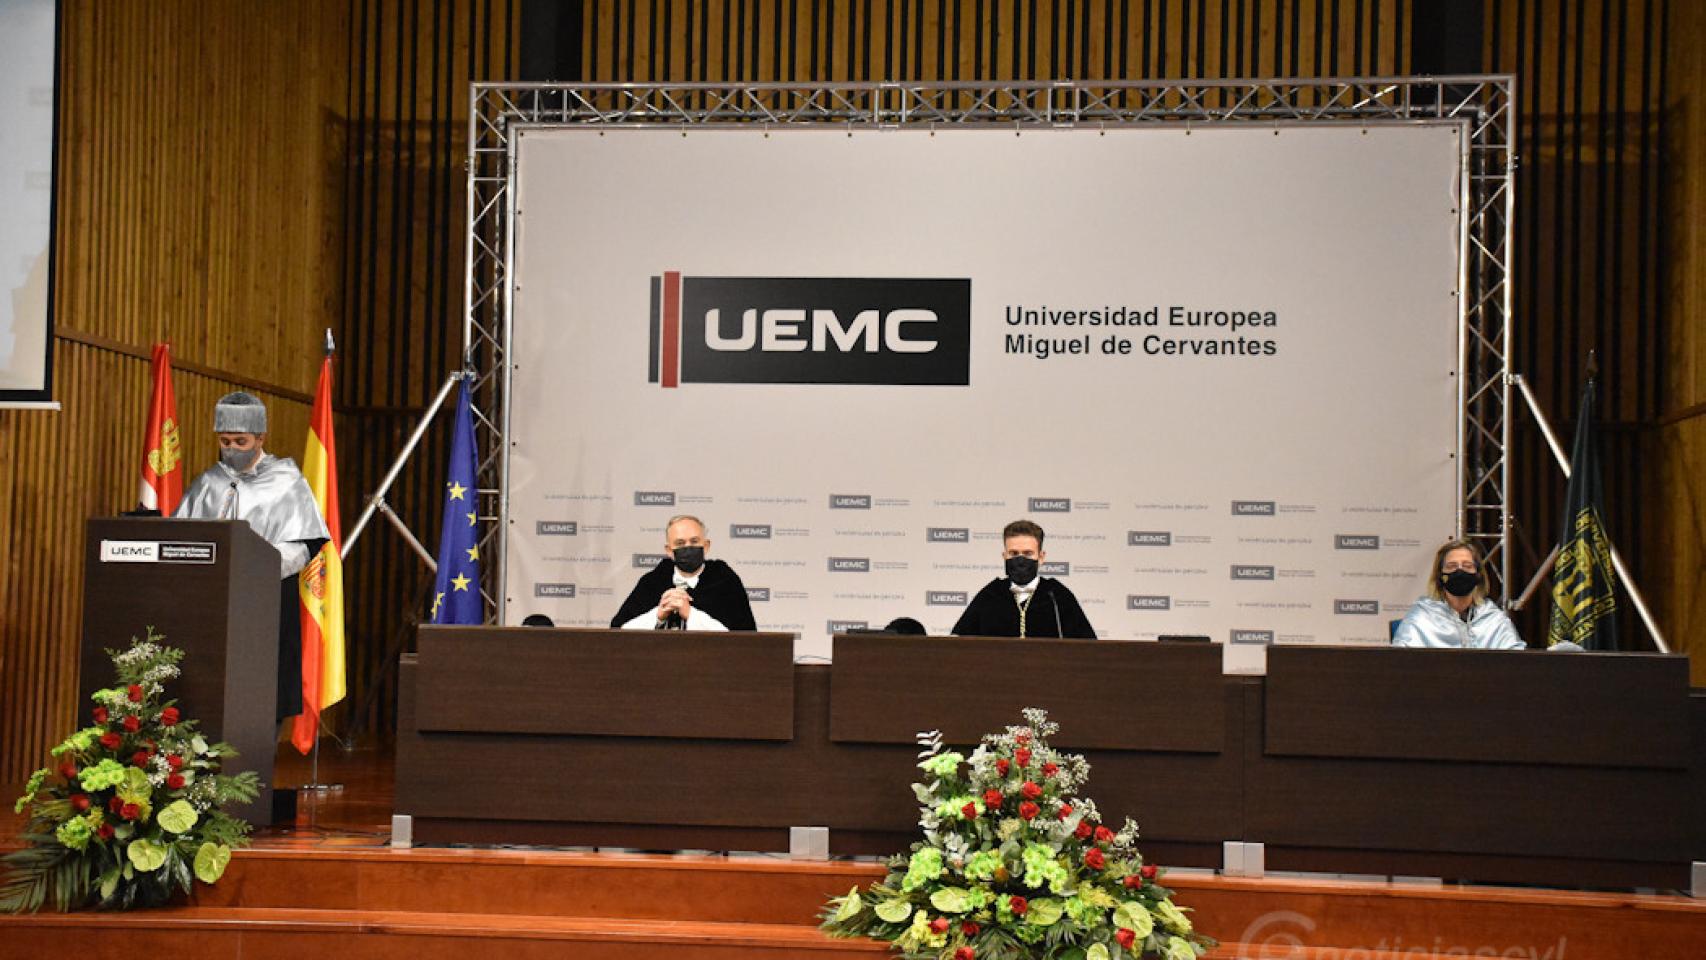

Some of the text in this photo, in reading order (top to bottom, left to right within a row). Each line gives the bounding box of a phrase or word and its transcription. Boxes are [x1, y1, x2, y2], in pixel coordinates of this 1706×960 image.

[1005, 305, 1277, 332] Universidad Europea
[705, 308, 938, 353] UEMC
[1004, 334, 1277, 359] Miguel de Cervantes
[640, 495, 672, 503] UEMC
[835, 498, 867, 506] UEMC
[1034, 501, 1067, 510] UEMC
[1237, 504, 1271, 513] UEMC
[542, 524, 574, 532] UEMC
[736, 527, 768, 536] UEMC
[933, 531, 965, 539] UEMC
[1134, 535, 1167, 543] UEMC
[1341, 538, 1375, 547] UEMC
[111, 546, 152, 556] UEMC
[834, 561, 865, 569] UEMC
[1237, 568, 1270, 577] UEMC
[540, 586, 572, 594] UEMC
[932, 594, 964, 602] UEMC
[1133, 598, 1166, 607] UEMC
[1340, 603, 1374, 612] UEMC
[1236, 633, 1270, 642] UEMC
